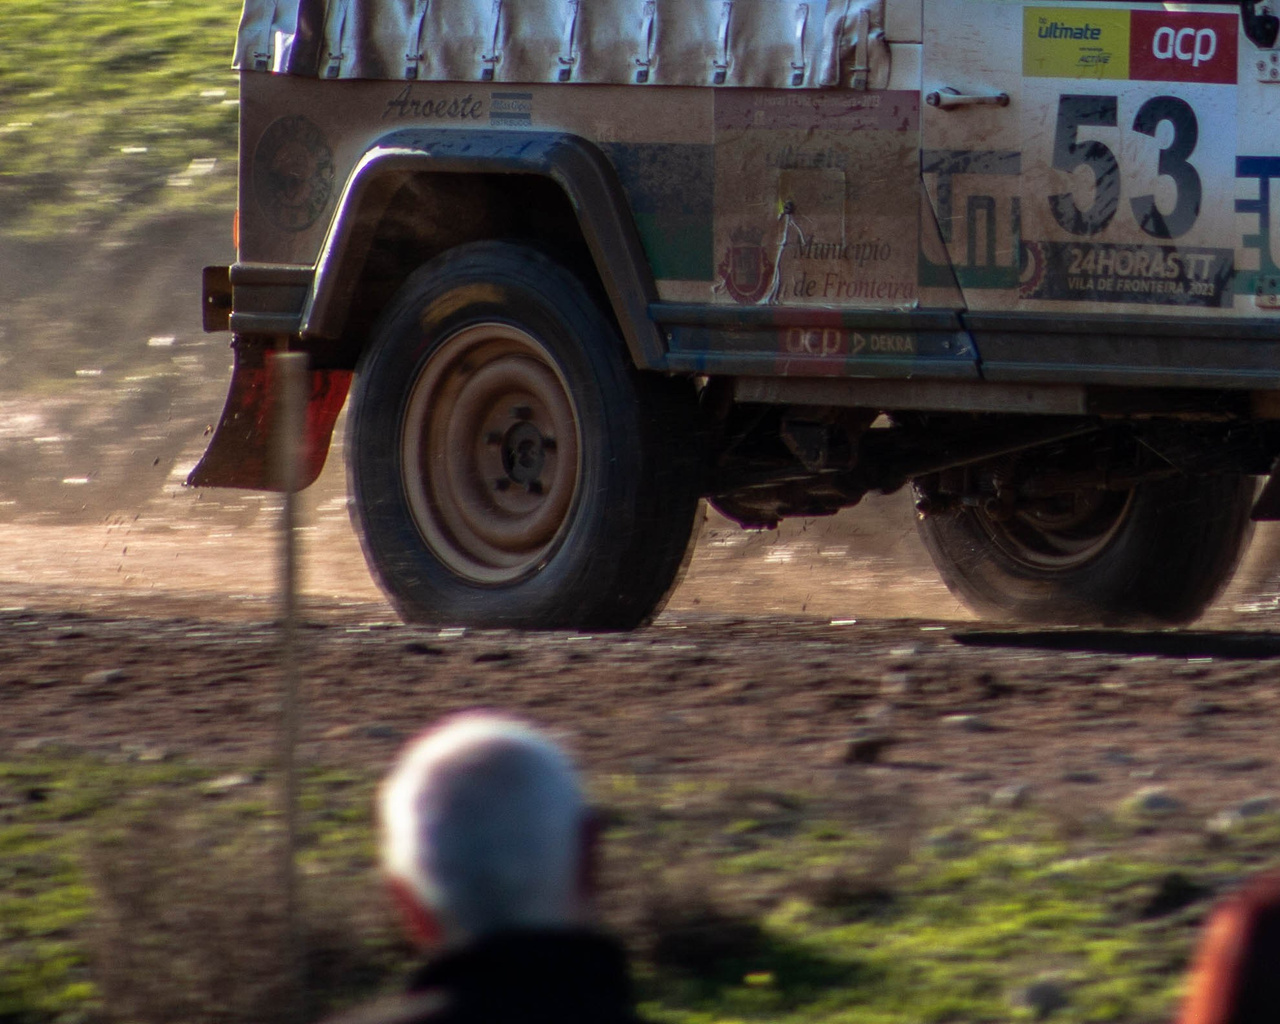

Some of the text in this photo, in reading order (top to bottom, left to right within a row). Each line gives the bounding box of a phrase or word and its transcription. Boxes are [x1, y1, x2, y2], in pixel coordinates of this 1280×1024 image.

[1038, 22, 1101, 40] ultimate
[1152, 27, 1217, 67] acp
[382, 83, 482, 120] Aroeste
[1047, 93, 1203, 240] 53
[1068, 248, 1216, 280] 24HORAS TT
[793, 271, 914, 299] de Fronteira
[1068, 278, 1215, 296] VILA DE FRONTEIRA 2023
[870, 336, 914, 353] DEKRA
